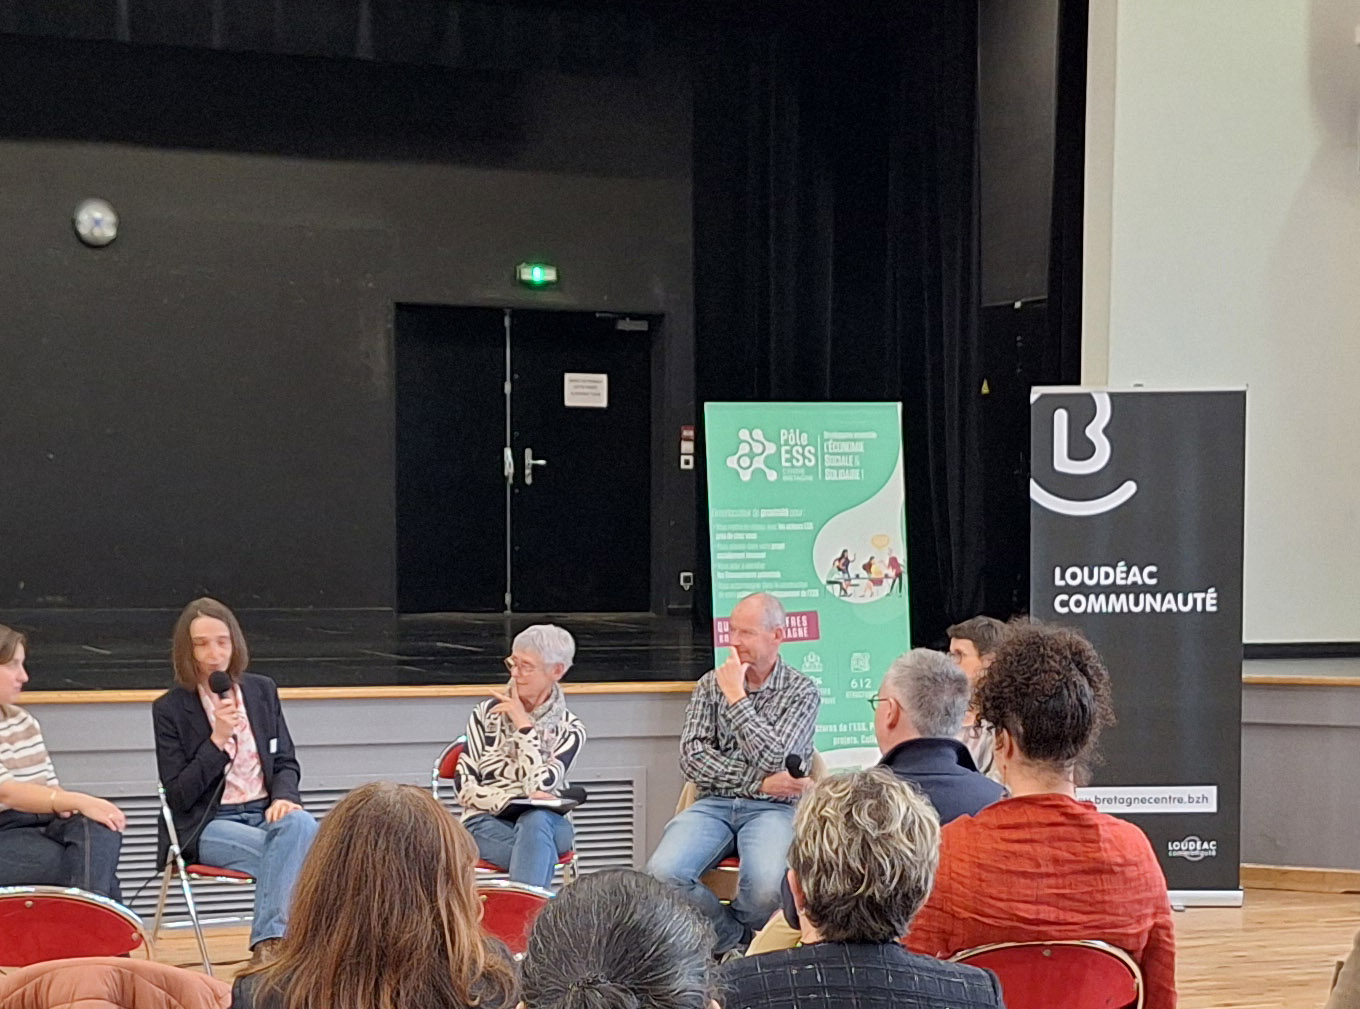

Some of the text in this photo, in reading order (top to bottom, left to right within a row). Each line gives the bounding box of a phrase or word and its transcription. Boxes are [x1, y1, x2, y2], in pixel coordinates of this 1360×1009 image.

[780, 429, 809, 446] Pôle
[781, 445, 816, 467] ESS
[1054, 561, 1158, 586] LOUDÉAC
[1053, 587, 1218, 614] COMMUNAUTÉ
[850, 678, 872, 689] 612
